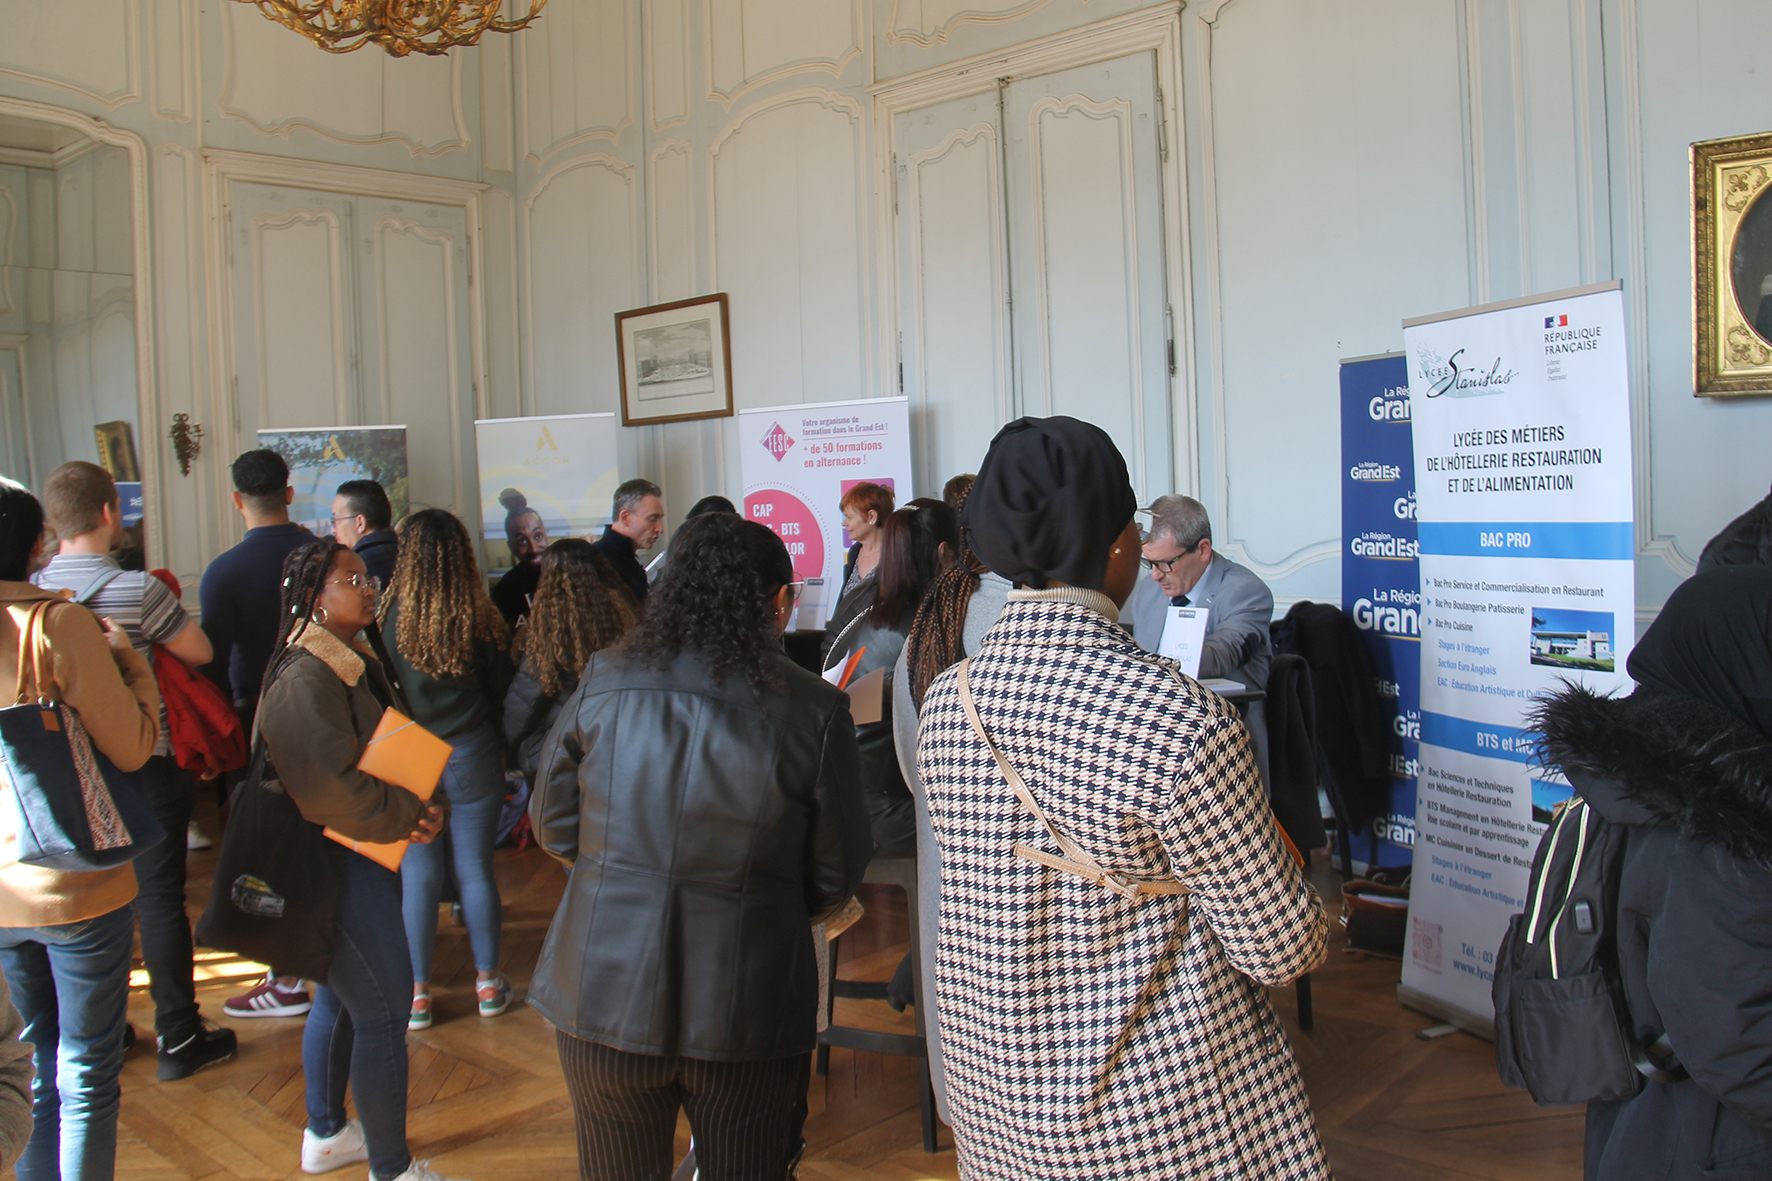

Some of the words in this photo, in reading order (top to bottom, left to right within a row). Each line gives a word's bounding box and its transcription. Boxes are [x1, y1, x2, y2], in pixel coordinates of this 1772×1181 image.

[1544, 326, 1601, 342] RÉPUBLIQUE
[1545, 340, 1597, 355] FRANÇAISE
[1426, 348, 1515, 398] Stanislas
[1384, 388, 1395, 396] La
[802, 428, 831, 436] formation
[832, 426, 846, 434] dans
[856, 424, 873, 432] Grand
[875, 423, 884, 431] Est
[820, 417, 850, 427] organisme
[1453, 428, 1483, 448] LYCÉE
[1486, 430, 1508, 445] DES
[1512, 424, 1565, 444] MÉTIERS
[810, 444, 820, 454] de
[822, 442, 834, 453] 50
[836, 440, 882, 452] formations
[524, 456, 570, 466] ACCOR
[804, 460, 814, 468] en
[816, 456, 861, 467] alternance
[1426, 457, 1439, 471] DE
[1440, 452, 1508, 471] L'HÔTELLERIE
[1512, 448, 1602, 468] RESTAURATION
[1448, 478, 1459, 492] ET
[1462, 478, 1474, 492] DE
[1478, 474, 1574, 492] L'ALIMENTATION
[753, 504, 773, 517] CAP
[781, 523, 800, 535] BTS
[1370, 532, 1391, 542] Région
[1480, 532, 1504, 548] BAC
[1506, 532, 1532, 548] PRO
[1374, 588, 1388, 602] La
[1434, 578, 1442, 588] Bac
[1444, 580, 1452, 588] Pro
[1452, 580, 1473, 590] Service
[1474, 582, 1480, 591] et
[1481, 582, 1550, 594] Commercialisation
[1552, 586, 1561, 594] en
[1563, 585, 1604, 597] Restaurant
[1435, 598, 1444, 608] Bac
[1444, 599, 1452, 608] Pro
[1453, 600, 1486, 613] Boulangerie
[1488, 604, 1524, 614] Patisserie
[1352, 598, 1422, 634] Gran
[1435, 618, 1444, 628] Bac
[1444, 620, 1452, 629] Pro
[1452, 621, 1473, 632] Cuisine
[1438, 640, 1455, 651] Stages
[1456, 642, 1461, 650] à
[1461, 643, 1490, 657] l'étranger
[1438, 658, 1457, 670] Section
[1458, 661, 1470, 672] Euro
[1471, 664, 1496, 676] Anglais
[1438, 677, 1448, 687] EAC
[1452, 678, 1479, 692] Éducation
[1480, 683, 1516, 698] Artistique
[1517, 688, 1524, 698] et
[1407, 710, 1416, 719] La
[1476, 732, 1499, 749] BTS
[1502, 737, 1514, 752] et
[1428, 766, 1439, 778] Bac
[1440, 770, 1465, 785] Sciences
[1467, 776, 1473, 786] et
[1474, 778, 1514, 794] Techniques
[1428, 782, 1435, 790] en
[1436, 783, 1465, 798] Hôtellerie
[1466, 790, 1512, 808] Restauration
[1427, 800, 1438, 811] BTS
[1440, 803, 1478, 821] Management
[1481, 815, 1489, 823] en
[1491, 816, 1526, 831] Hôtellerie
[1427, 814, 1438, 824] Voie
[1439, 819, 1462, 831] scolaire
[1463, 824, 1468, 832] et
[1470, 826, 1480, 836] par
[1482, 828, 1529, 848] apprentissage
[1426, 833, 1436, 843] MC
[1437, 836, 1464, 852] Cuisinier
[1465, 845, 1474, 854] en
[1475, 846, 1501, 861] Dessert
[1502, 854, 1511, 863] de
[1432, 854, 1453, 869] Stages
[1460, 862, 1492, 880] l'étranger
[1432, 873, 1444, 885] EAC
[1449, 876, 1481, 895] Éducation
[1482, 888, 1515, 905] Artistique
[1517, 898, 1524, 908] et
[1462, 942, 1476, 958] Tél.
[1482, 950, 1494, 964] 03
